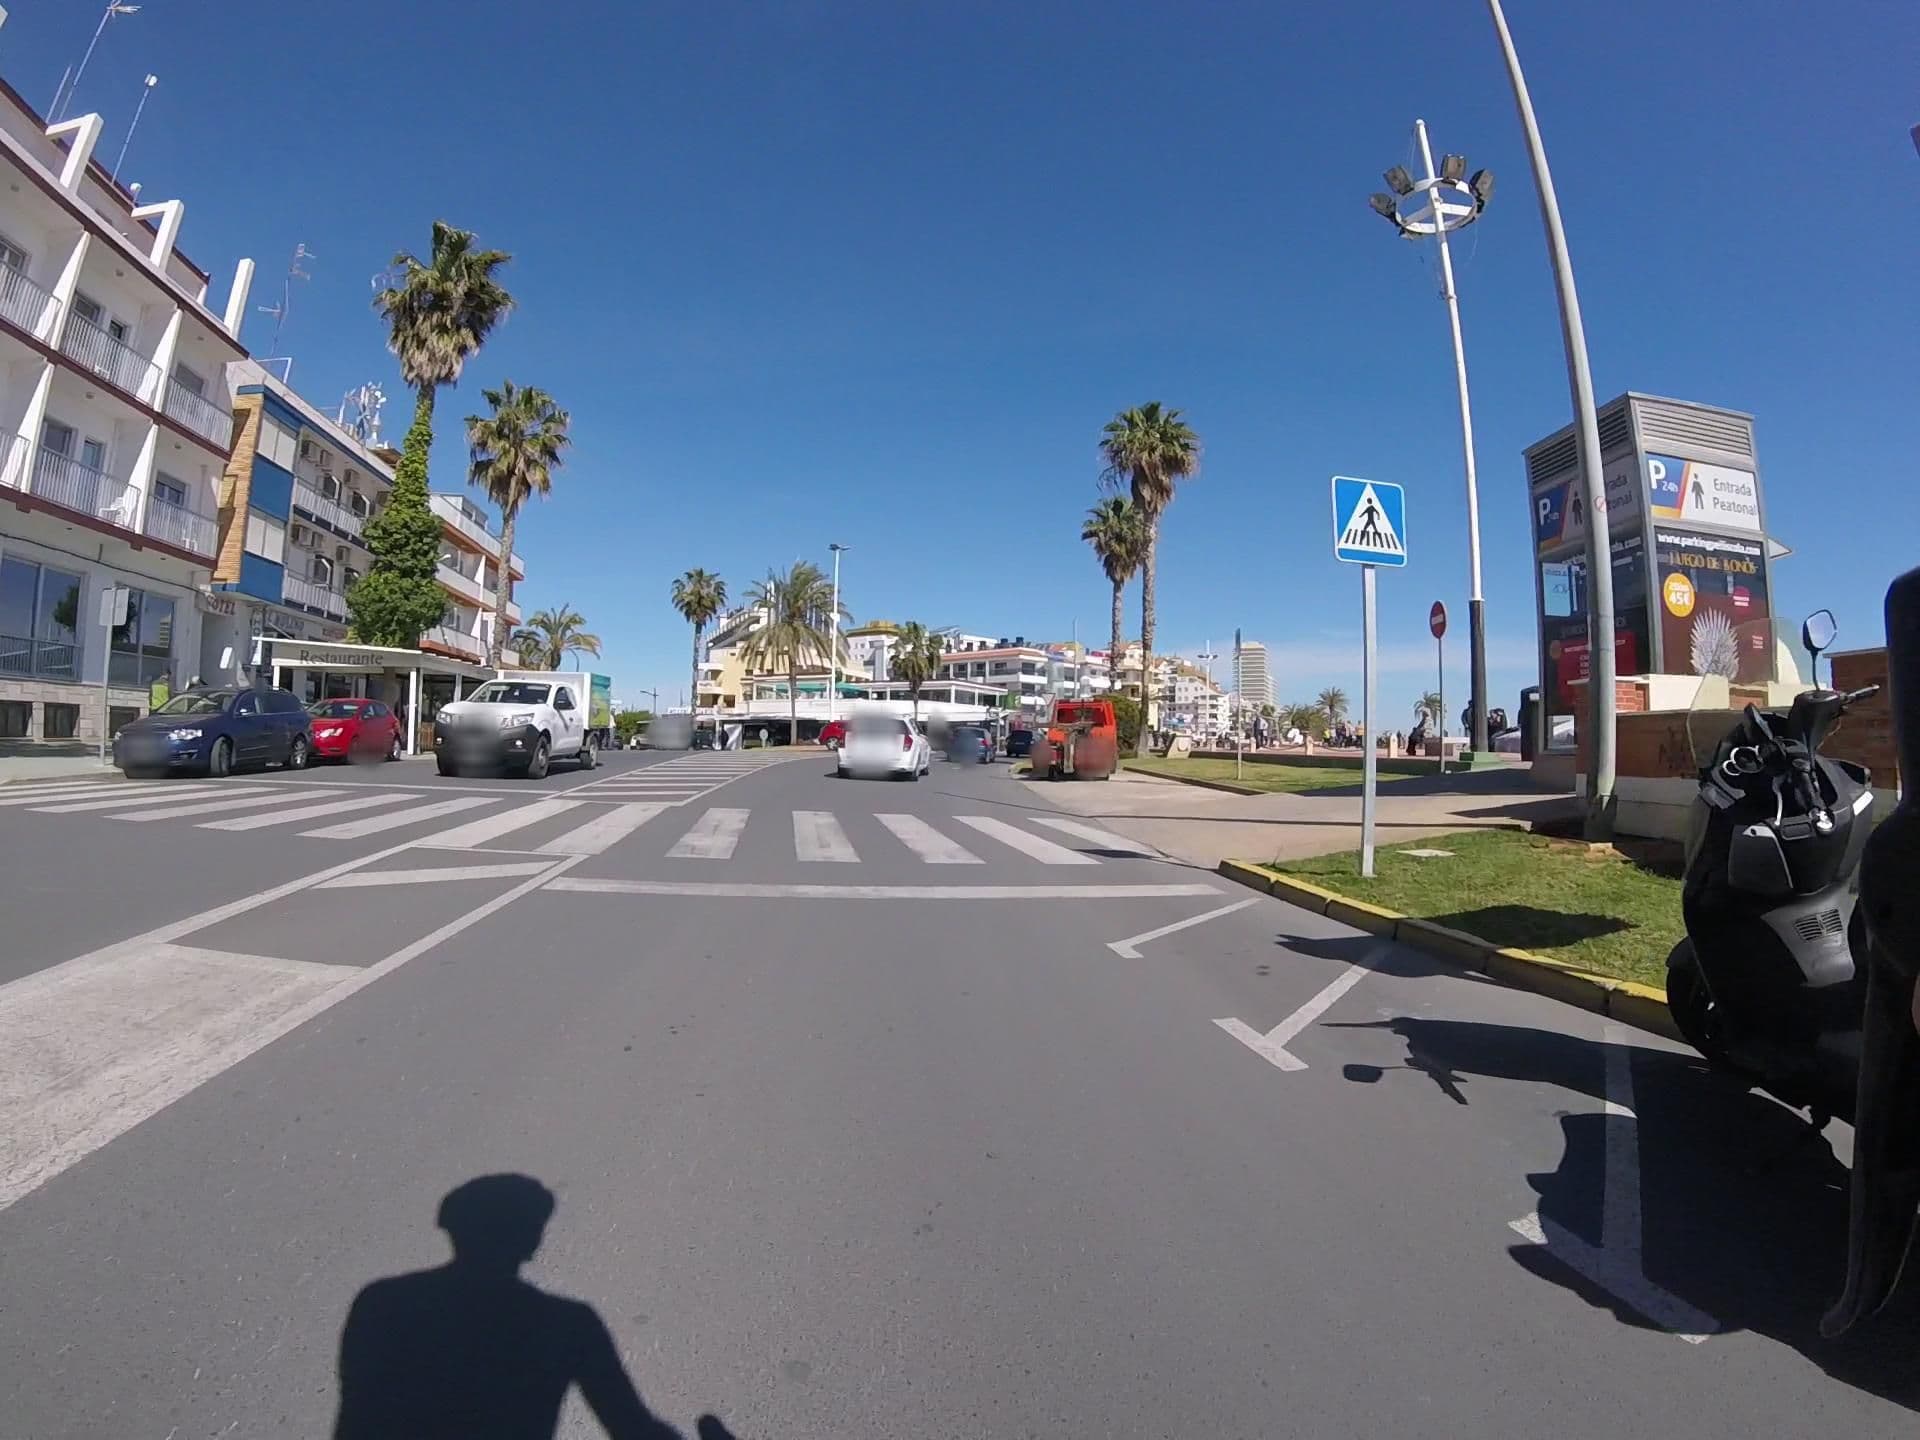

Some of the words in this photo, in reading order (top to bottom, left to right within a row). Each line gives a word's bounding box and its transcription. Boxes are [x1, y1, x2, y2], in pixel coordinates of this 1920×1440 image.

[1648, 459, 1666, 490] P
[1713, 478, 1752, 497] Entrada
[1539, 498, 1551, 526] P
[1713, 497, 1758, 516] Peatonal
[300, 649, 384, 665] Restaurante
